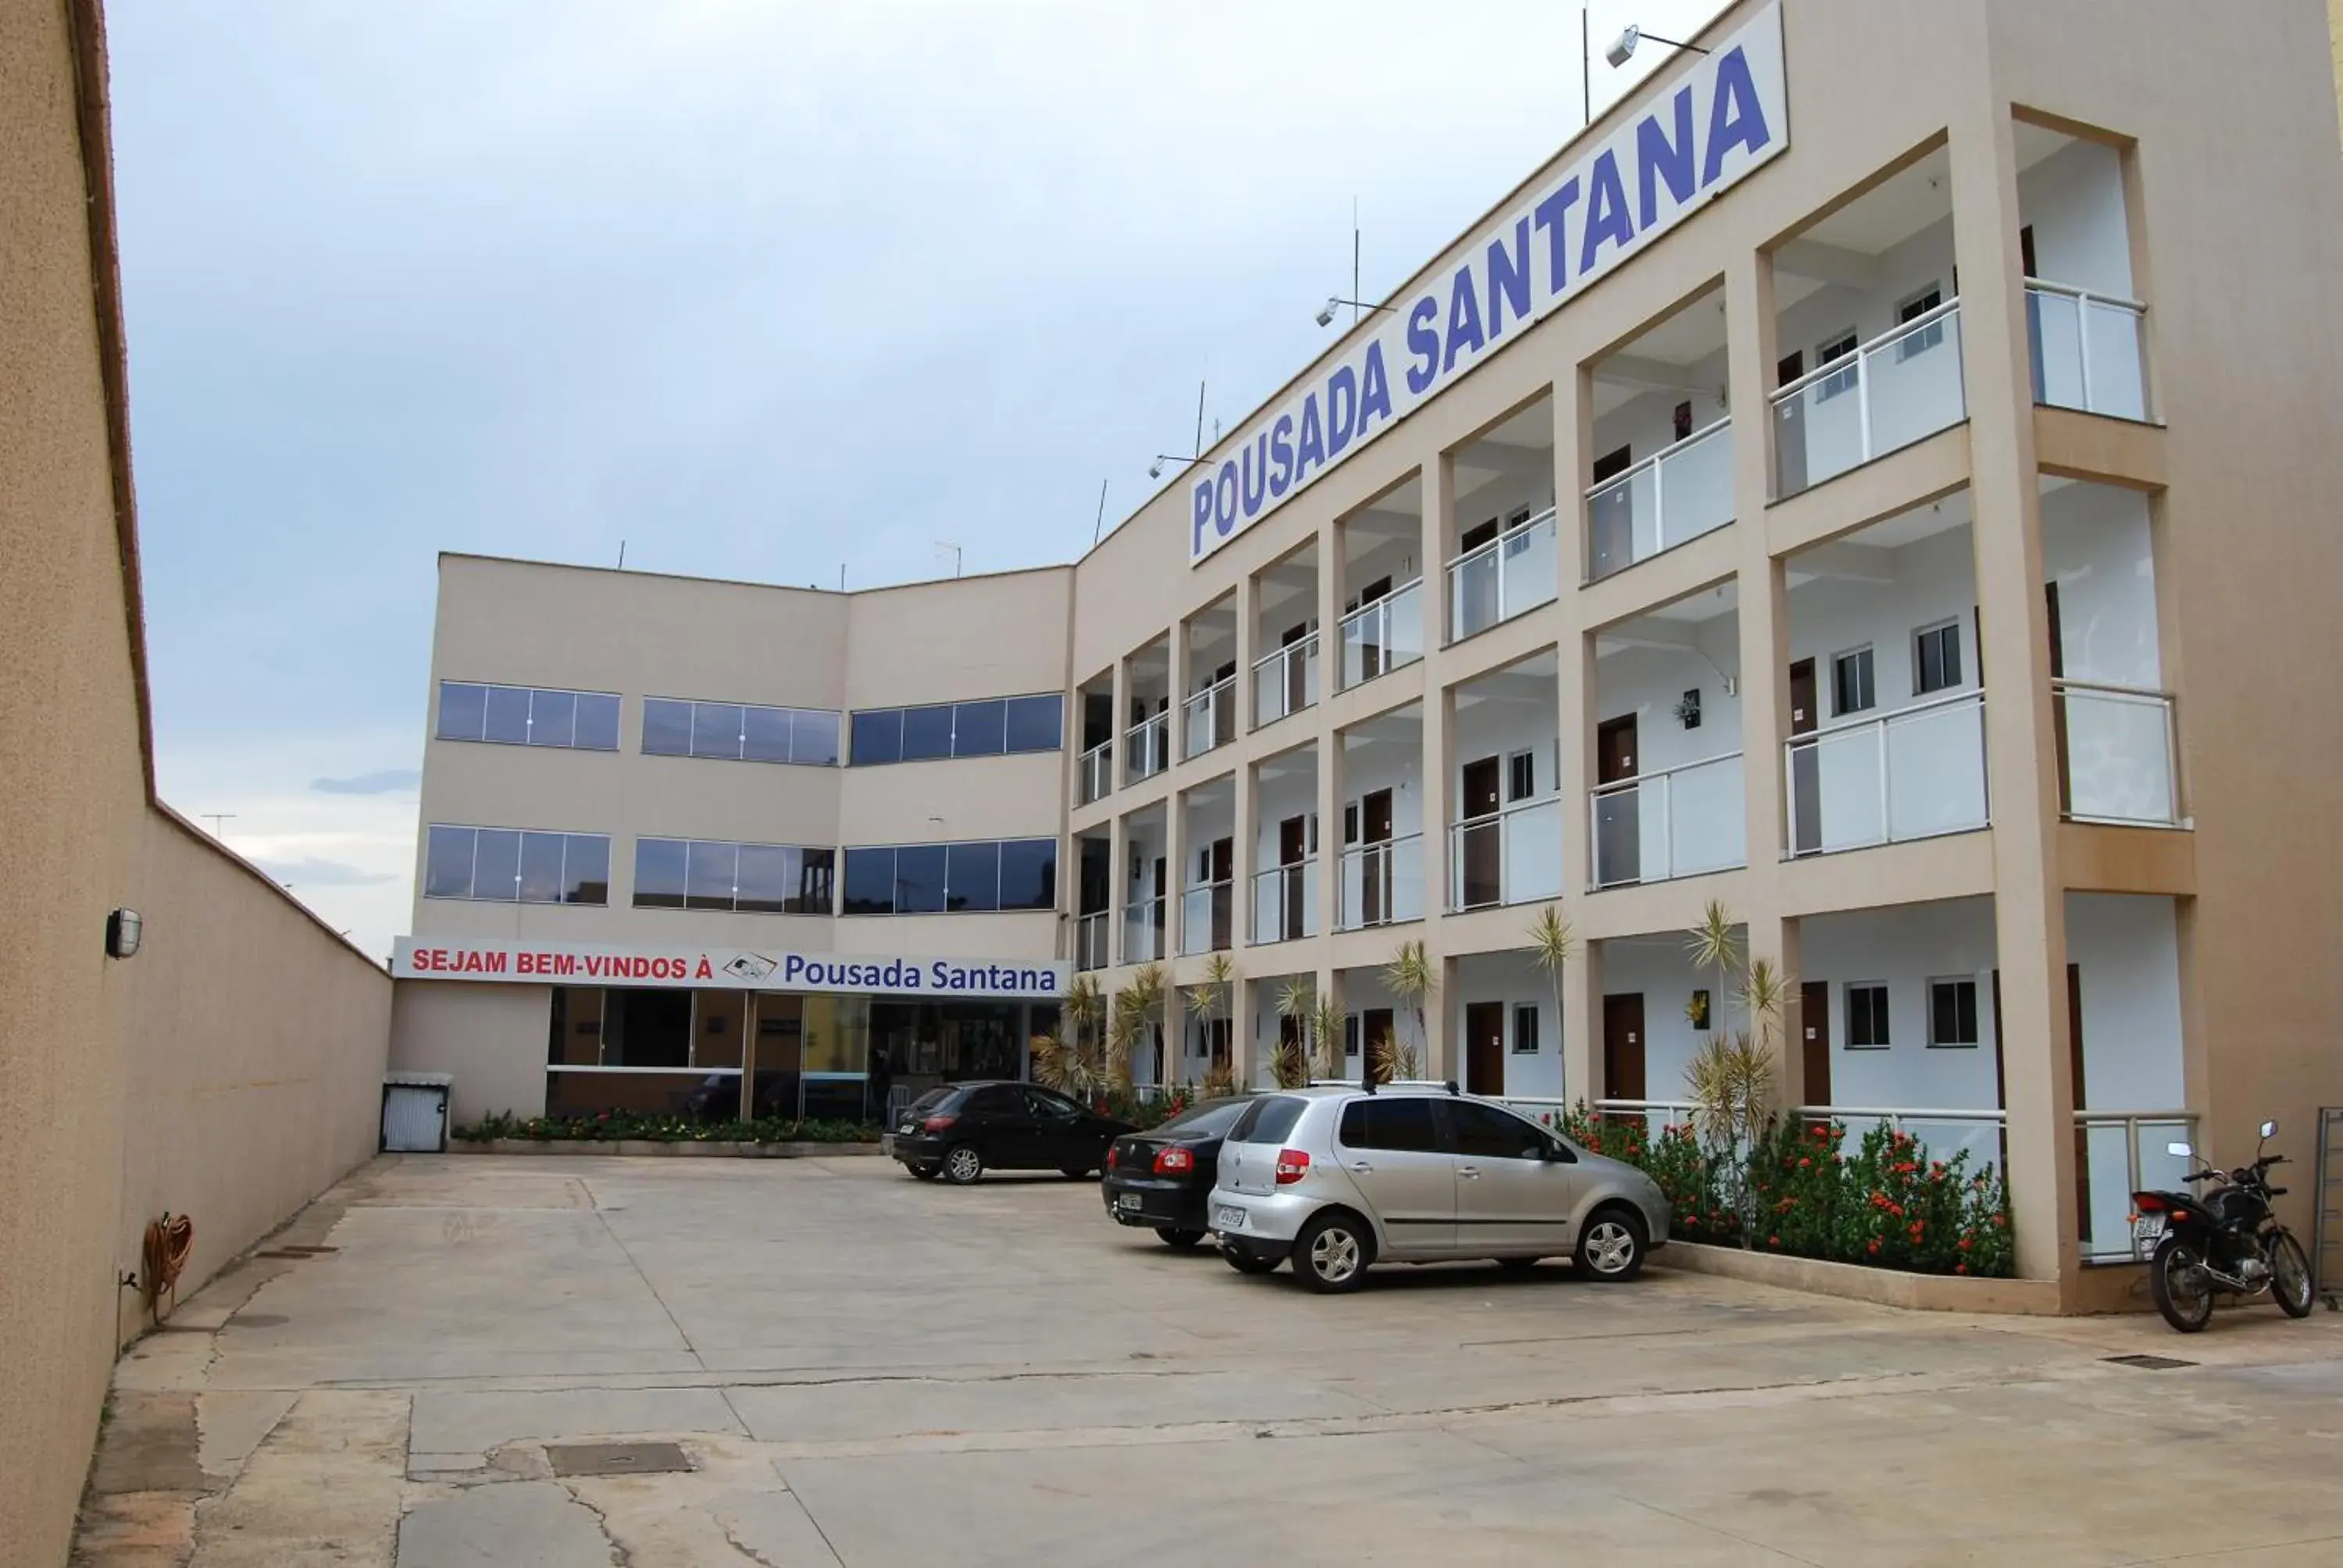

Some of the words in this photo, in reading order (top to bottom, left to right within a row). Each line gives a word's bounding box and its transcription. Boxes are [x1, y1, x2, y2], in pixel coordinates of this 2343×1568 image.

[1193, 338, 1393, 557] POUSADA
[1406, 45, 1772, 395] SANTANA
[412, 949, 508, 974] SEJAM
[516, 952, 688, 980] BEM-VINDOS
[694, 954, 714, 980] À
[785, 954, 922, 988] Pousada
[932, 961, 1057, 991] Santana
